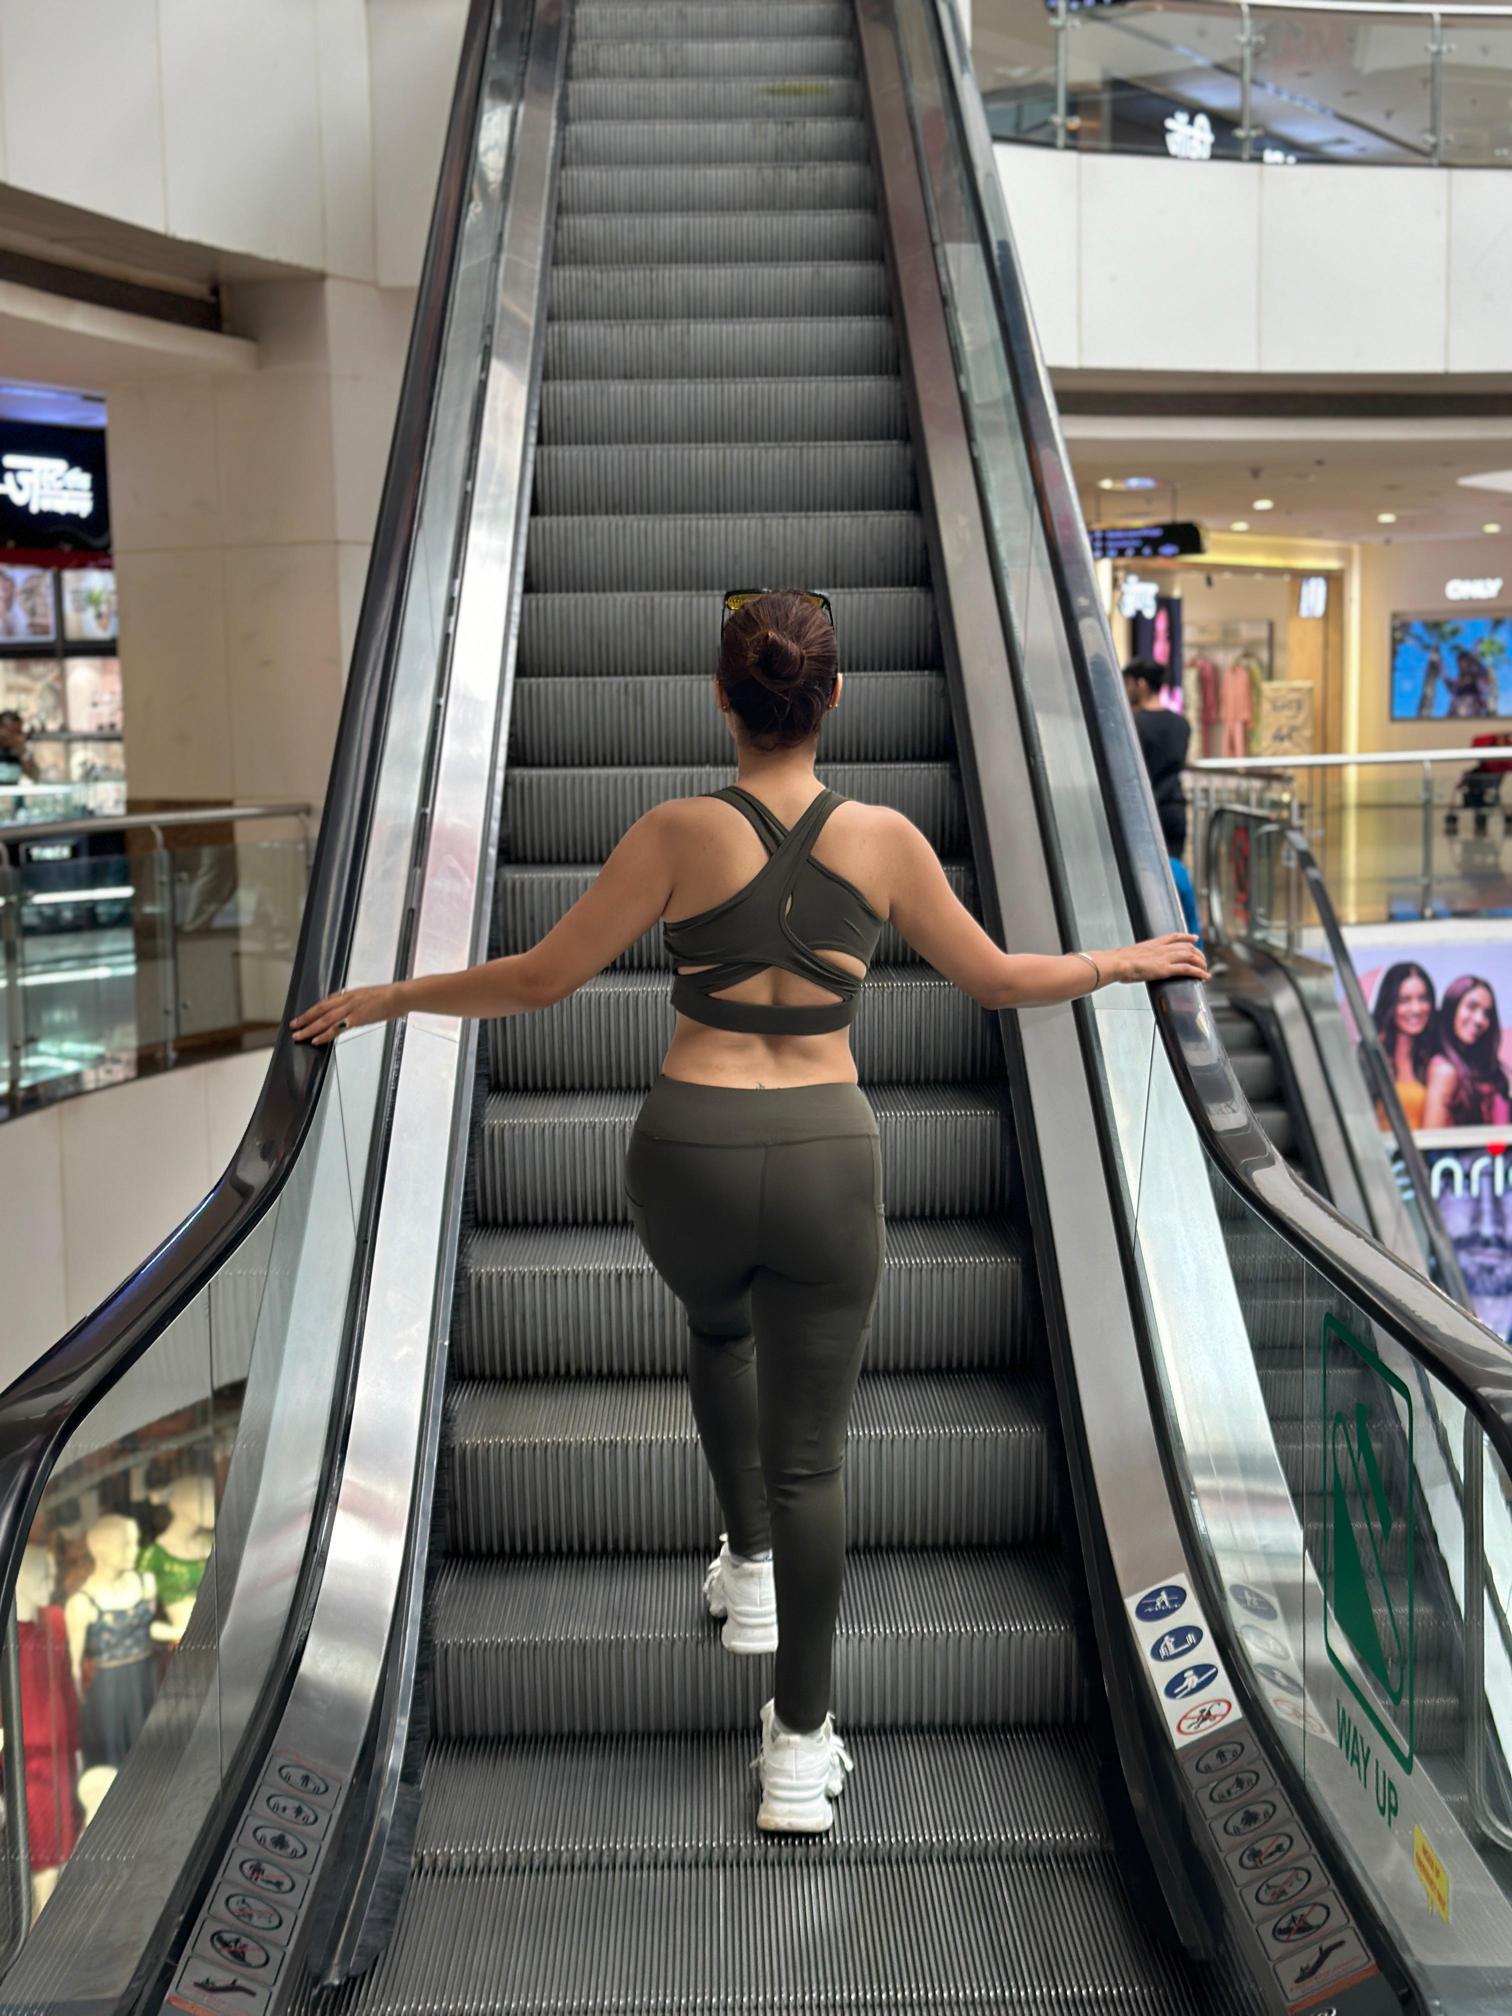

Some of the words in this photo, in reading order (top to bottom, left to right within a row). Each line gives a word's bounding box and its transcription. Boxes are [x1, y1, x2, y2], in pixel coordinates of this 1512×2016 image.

[1445, 577, 1503, 600] ONLY
[1336, 1698, 1370, 1789] WAY
[1375, 1758, 1398, 1828] UP
